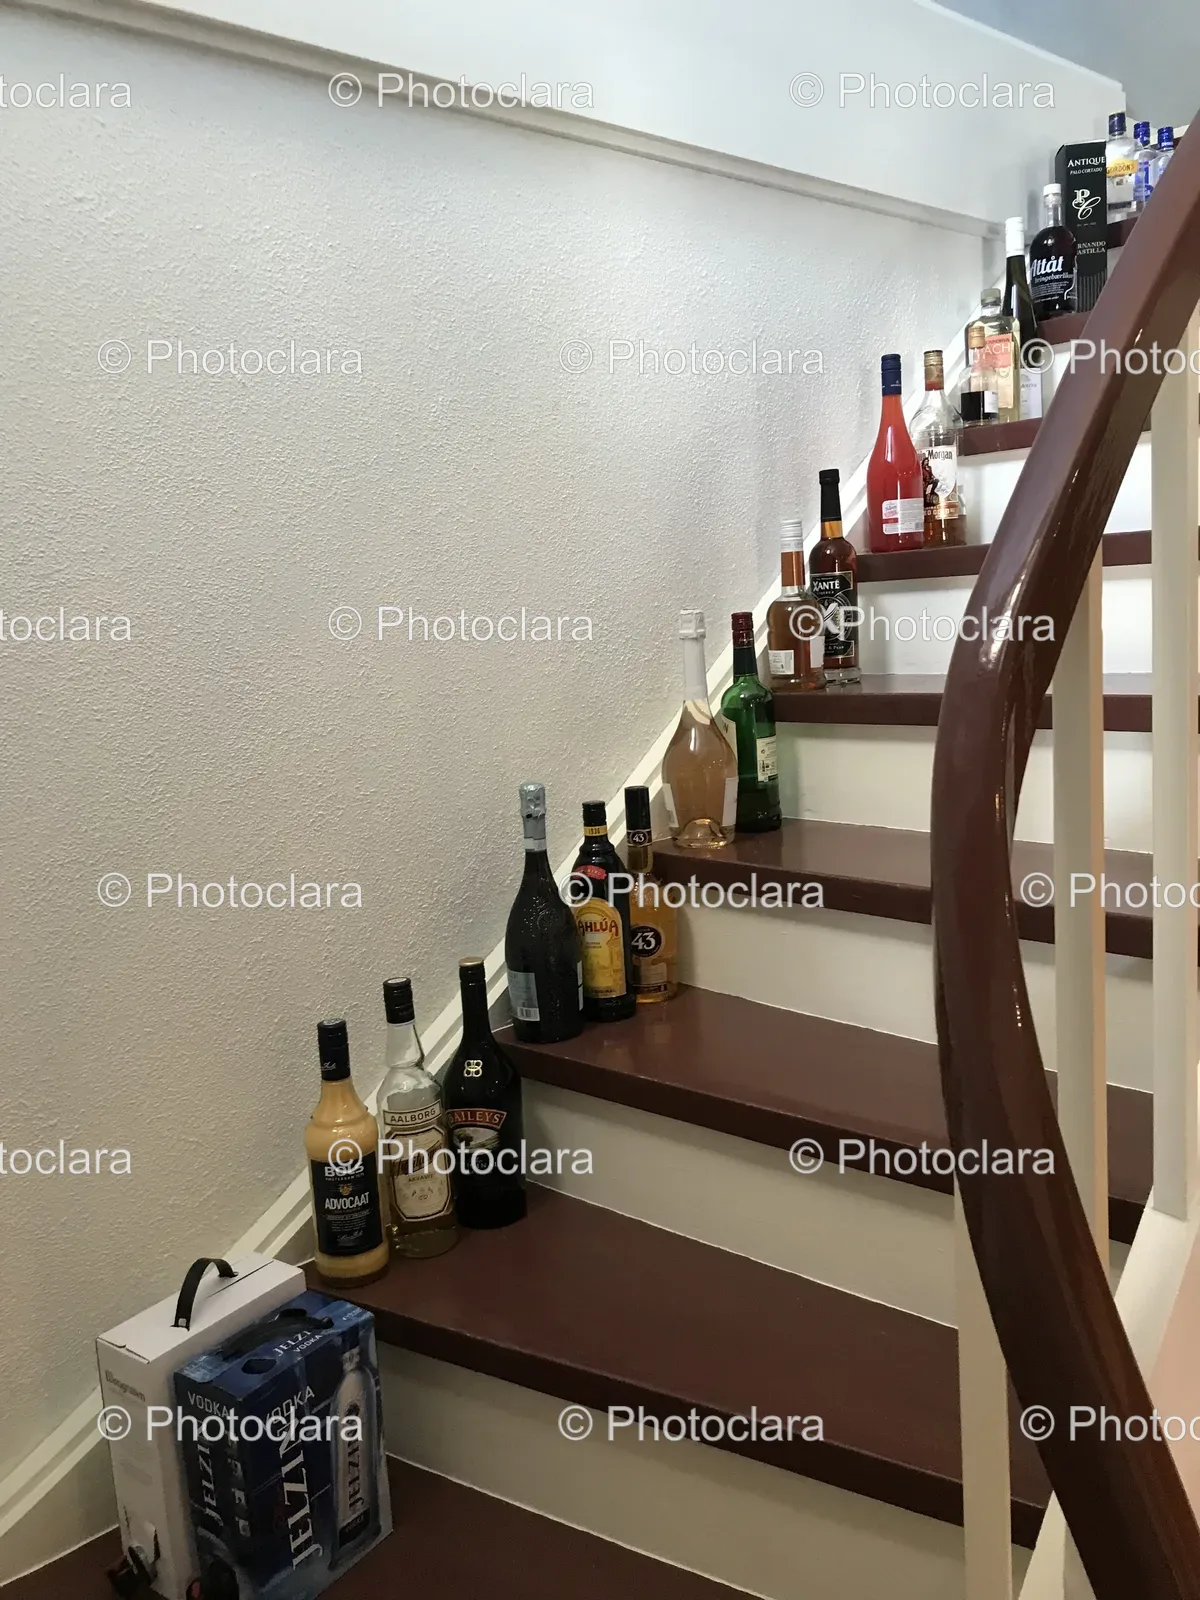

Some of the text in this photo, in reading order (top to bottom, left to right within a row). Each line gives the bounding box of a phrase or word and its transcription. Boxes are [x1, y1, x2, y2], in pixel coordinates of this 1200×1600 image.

[1067, 156, 1105, 168] ANTIQUE
[927, 449, 953, 460] Morgan
[812, 580, 840, 593] XANTÉ
[632, 833, 645, 843] 43
[578, 916, 620, 938] AHLÚA
[631, 931, 656, 950] 43
[390, 1107, 436, 1123] AALBORG
[324, 1191, 370, 1210] ADVOCAAT
[293, 1334, 323, 1353] VODKA
[187, 1391, 229, 1418] VODKA
